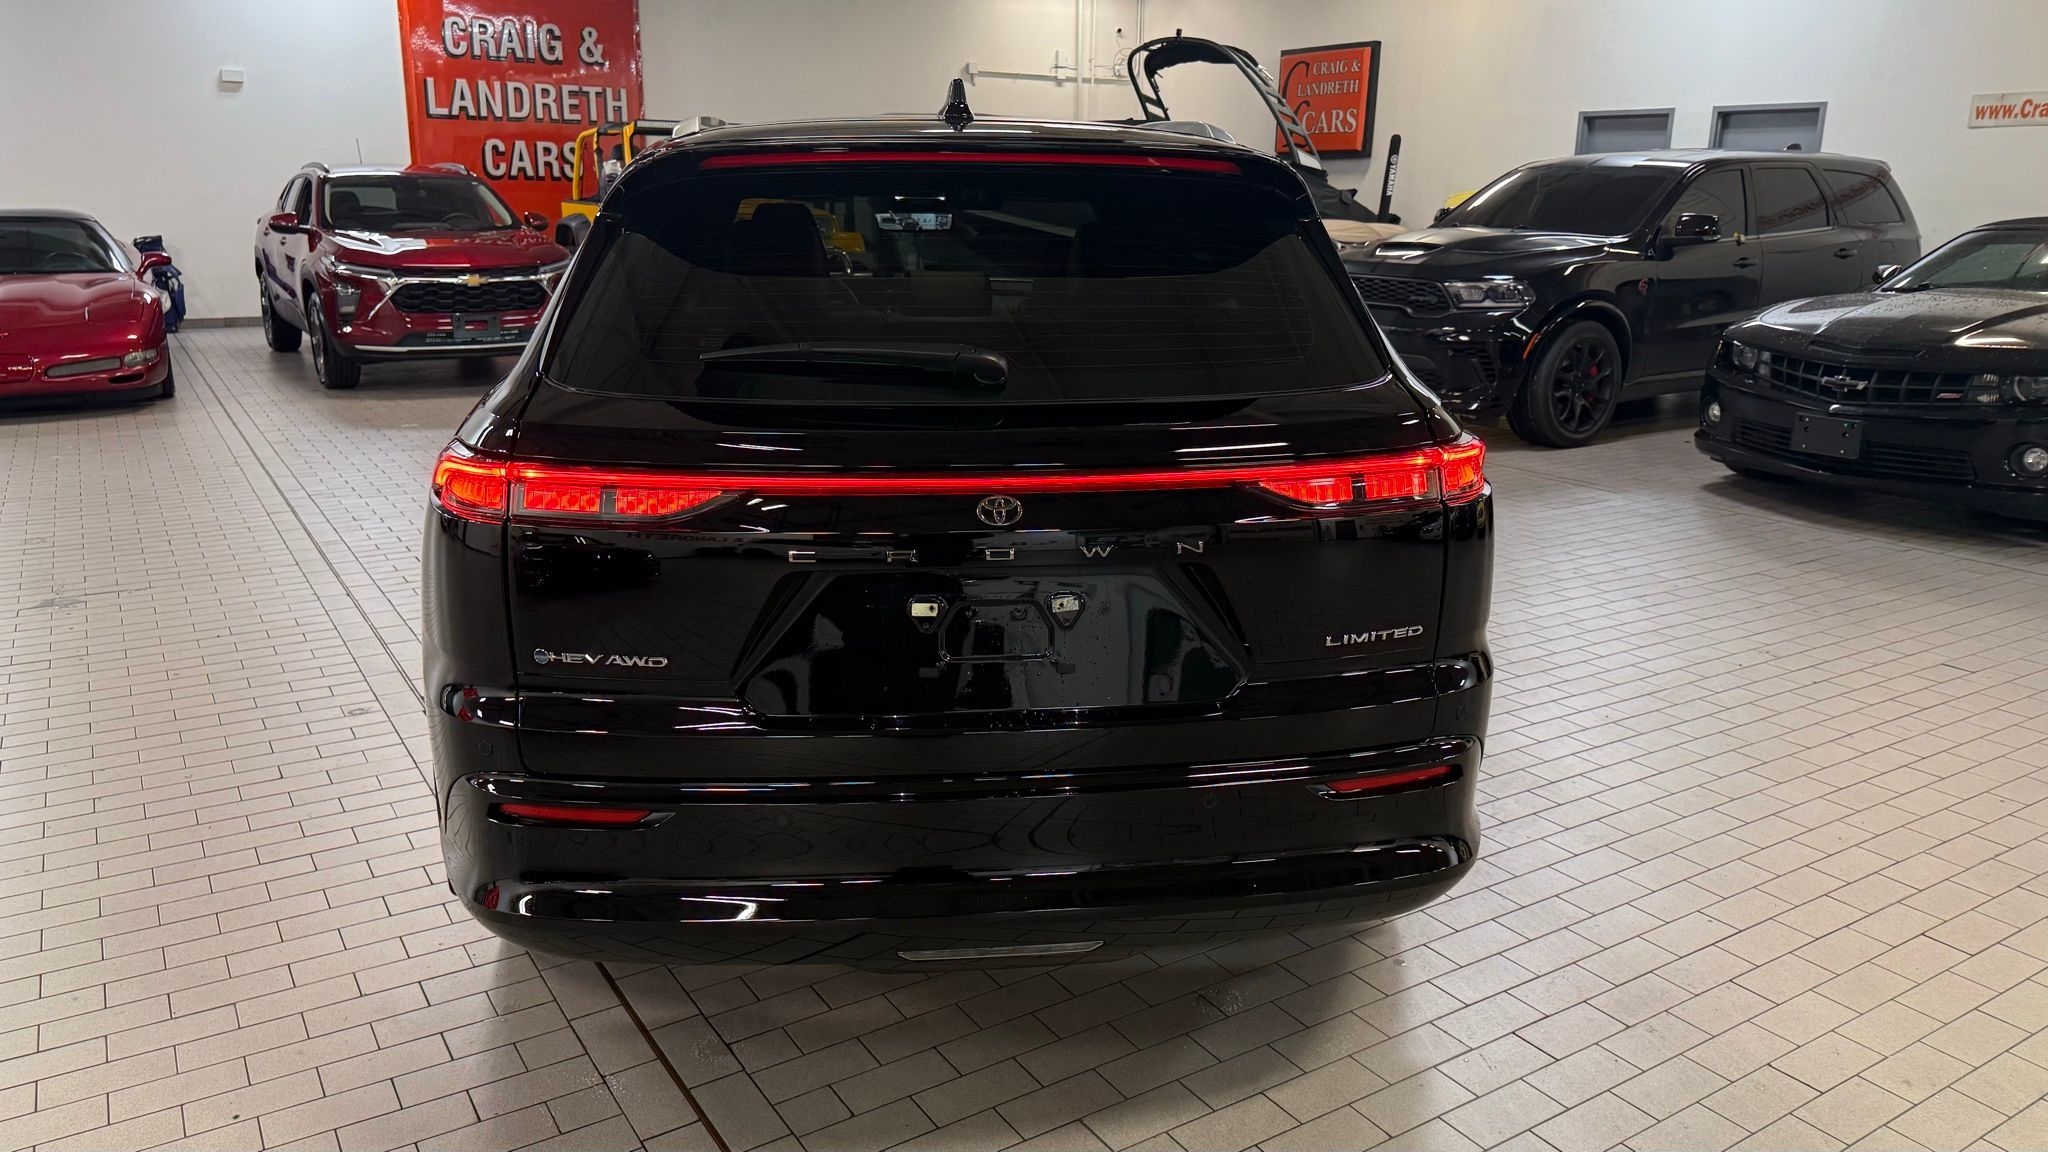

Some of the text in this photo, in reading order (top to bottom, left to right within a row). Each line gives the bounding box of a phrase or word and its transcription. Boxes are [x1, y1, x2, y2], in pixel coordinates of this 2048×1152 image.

[442, 16, 605, 66] CRAIG &
[1313, 59, 1361, 75] CRAIG &
[425, 77, 628, 124] LANDRETH
[1297, 80, 1359, 97] LANDRETH
[1302, 108, 1357, 135] CARS
[482, 139, 583, 181] CARS
[1386, 164, 1397, 196] YAMAHA
[1325, 625, 1424, 646] LIMITED
[605, 655, 668, 667] AWD
